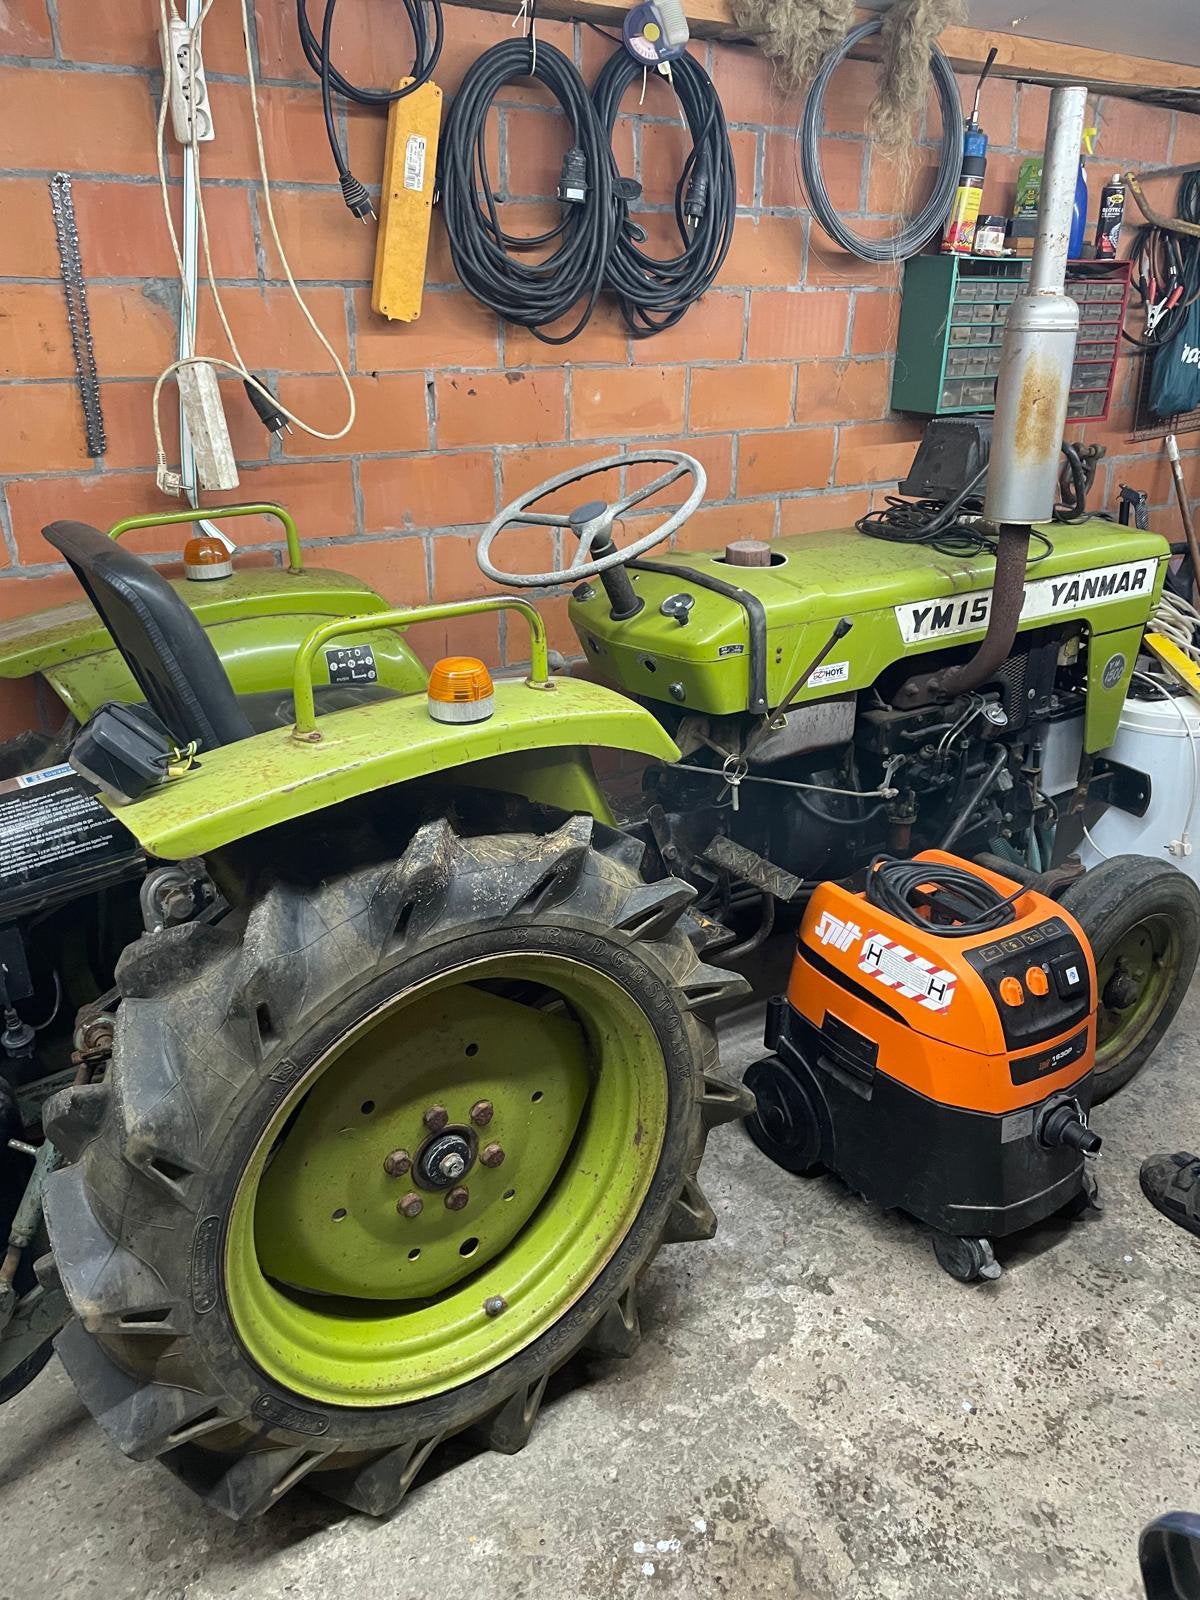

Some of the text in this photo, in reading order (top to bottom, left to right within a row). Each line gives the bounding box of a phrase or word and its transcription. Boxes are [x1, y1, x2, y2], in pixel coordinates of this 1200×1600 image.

[1051, 568, 1147, 606] YANMAR
[338, 649, 361, 658] PTO
[866, 943, 883, 966] H
[927, 978, 946, 1001] H
